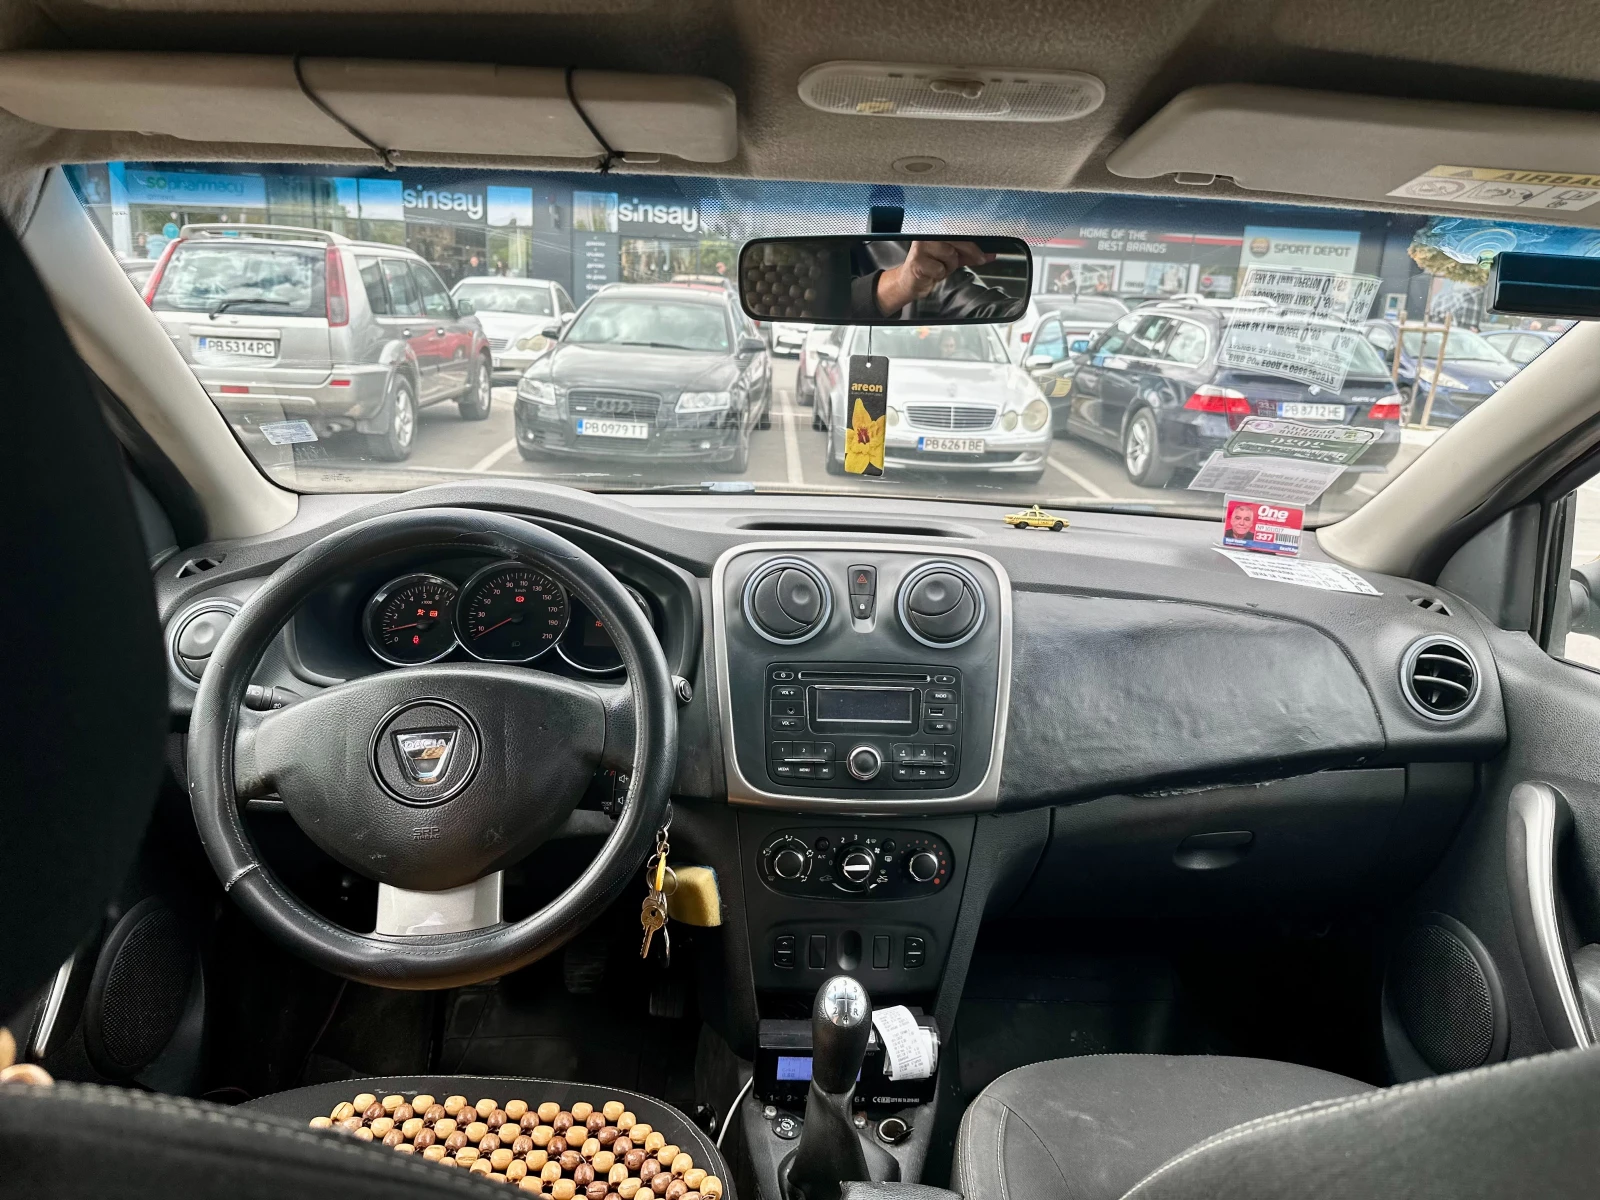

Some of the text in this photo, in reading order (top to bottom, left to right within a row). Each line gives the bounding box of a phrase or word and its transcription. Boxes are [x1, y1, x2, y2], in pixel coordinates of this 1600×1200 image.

[403, 185, 483, 220] sinsay
[618, 198, 699, 232] sinsay
[1079, 228, 1148, 240] HOME OF THE
[1097, 241, 1168, 253] BEST BRANDS
[1274, 243, 1312, 255] SPORT
[1313, 245, 1352, 258] DEPOT
[851, 382, 883, 393] areon
[1257, 505, 1289, 519] One
[1256, 532, 1273, 541] 337
[412, 827, 441, 836] SRP
[842, 1014, 849, 1022] 4
[853, 1008, 859, 1016] R
